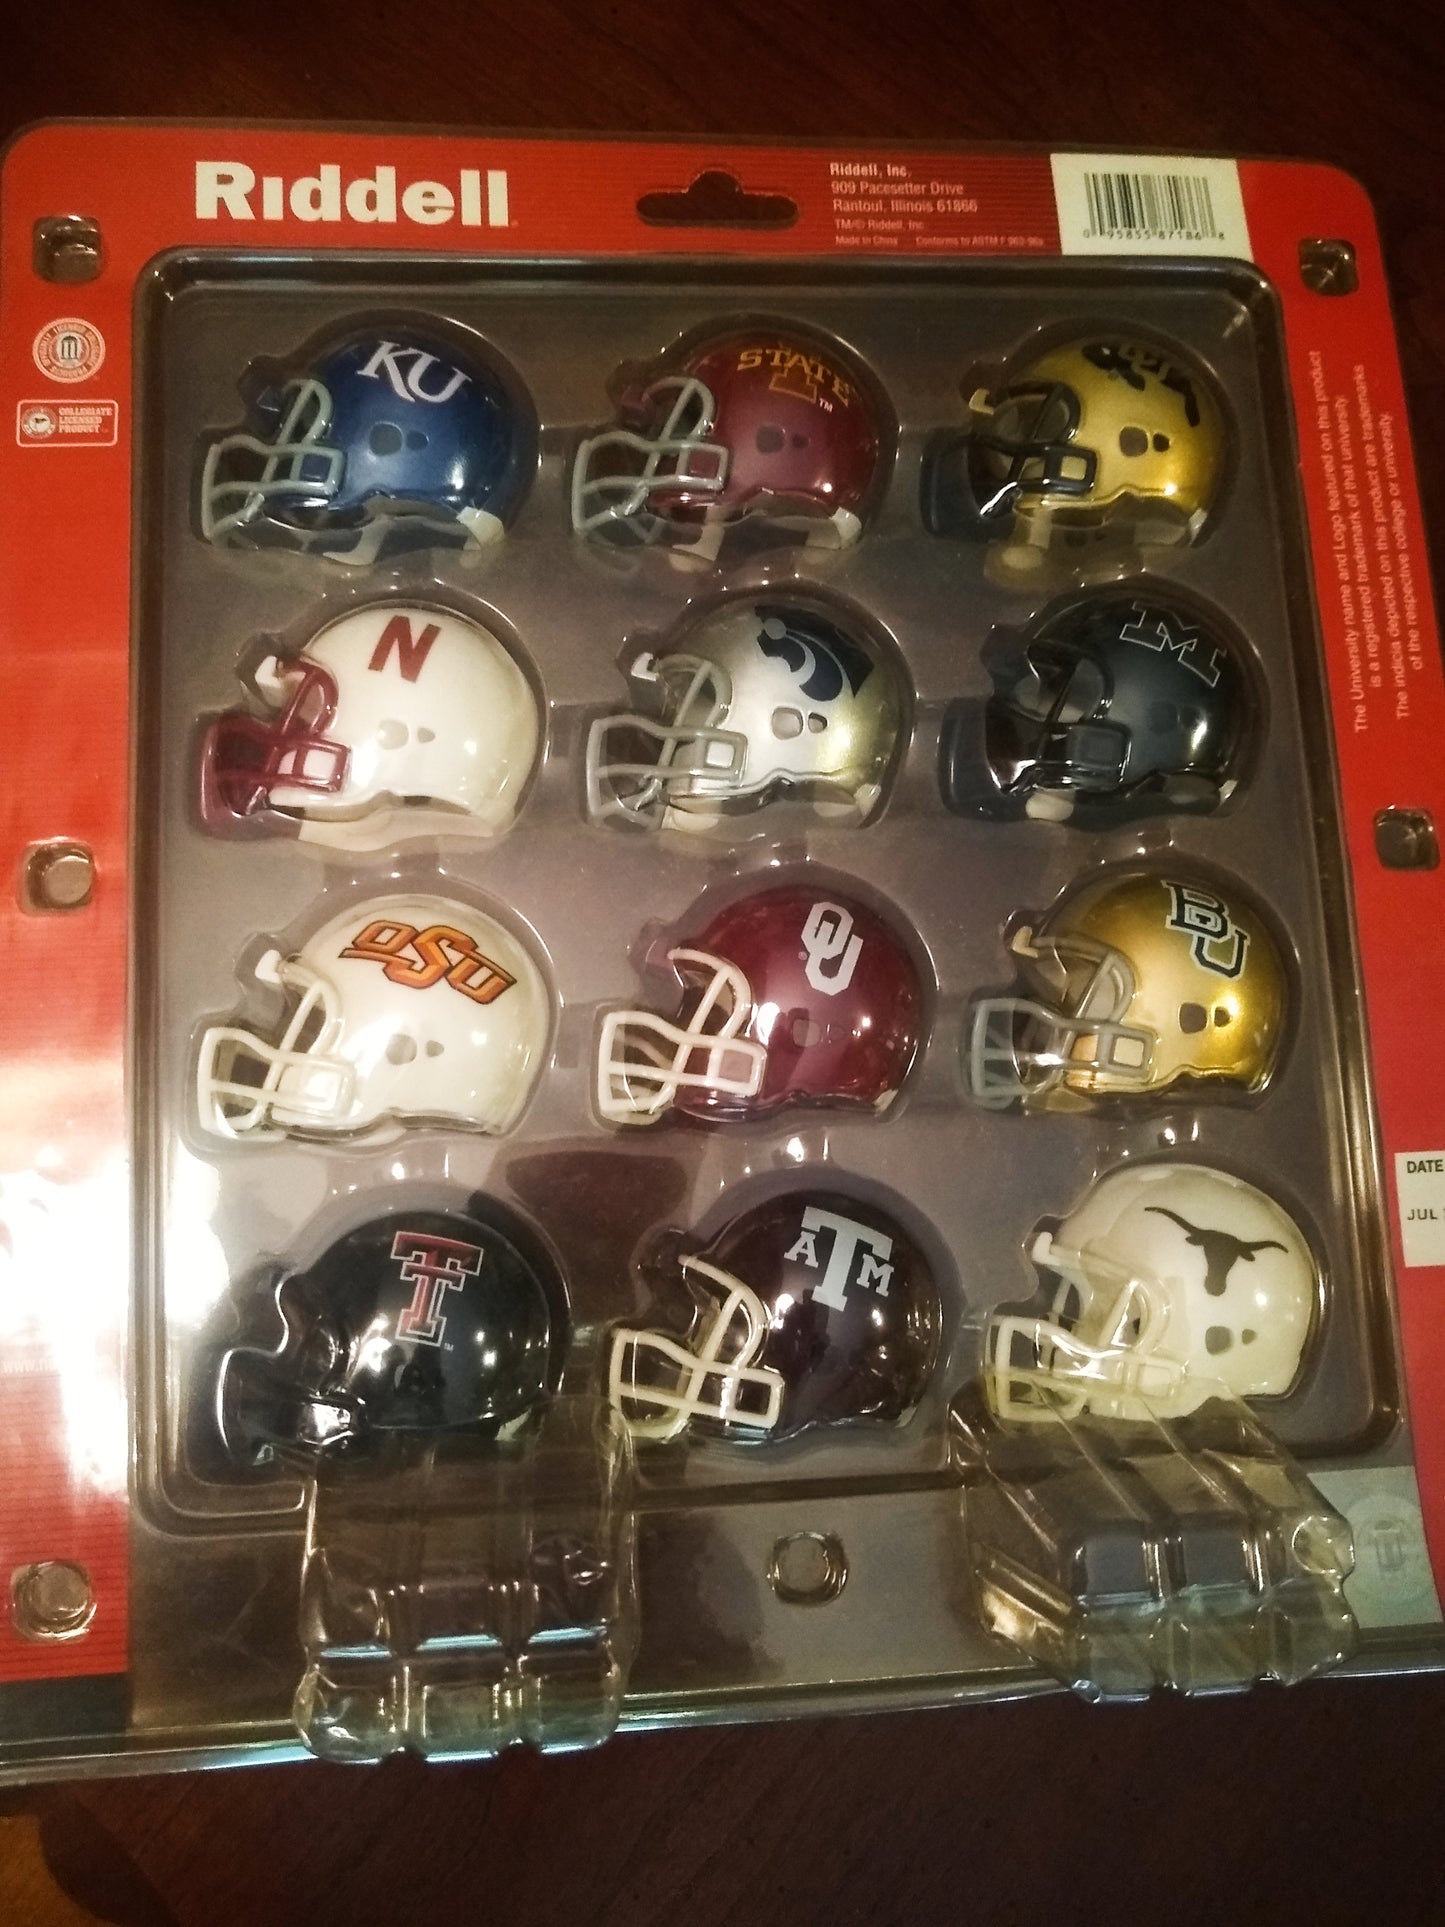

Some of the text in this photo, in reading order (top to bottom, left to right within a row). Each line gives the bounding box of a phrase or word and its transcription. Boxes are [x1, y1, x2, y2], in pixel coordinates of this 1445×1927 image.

[830, 163, 882, 178] Riddell,
[831, 181, 964, 195] 909 Pacesetter Drive
[196, 161, 509, 227] Riddell
[833, 199, 978, 213] Rantoul, Illinois 61866
[873, 236, 898, 246] China
[357, 341, 472, 403] KU
[738, 348, 857, 408] STATE
[1342, 465, 1357, 490] that
[1388, 482, 1400, 496] or
[1345, 493, 1359, 508] of
[1309, 351, 1369, 733] The University name and Logo featured on this product
[1353, 364, 1411, 720] The indicia depicted on this product are trademarks
[1390, 499, 1408, 549] college
[1348, 511, 1369, 582] trademark
[1398, 553, 1417, 625] respective
[1357, 586, 1380, 658] registered
[1407, 629, 1421, 651] the
[368, 614, 442, 684] N
[1369, 662, 1380, 671] a
[1409, 656, 1423, 670] of
[1369, 675, 1382, 688] is
[801, 901, 864, 996] OU
[1160, 879, 1251, 981] BU
[338, 919, 518, 1005] OSU
[1406, 1159, 1444, 1174] DATE
[1407, 1208, 1438, 1221] JUL
